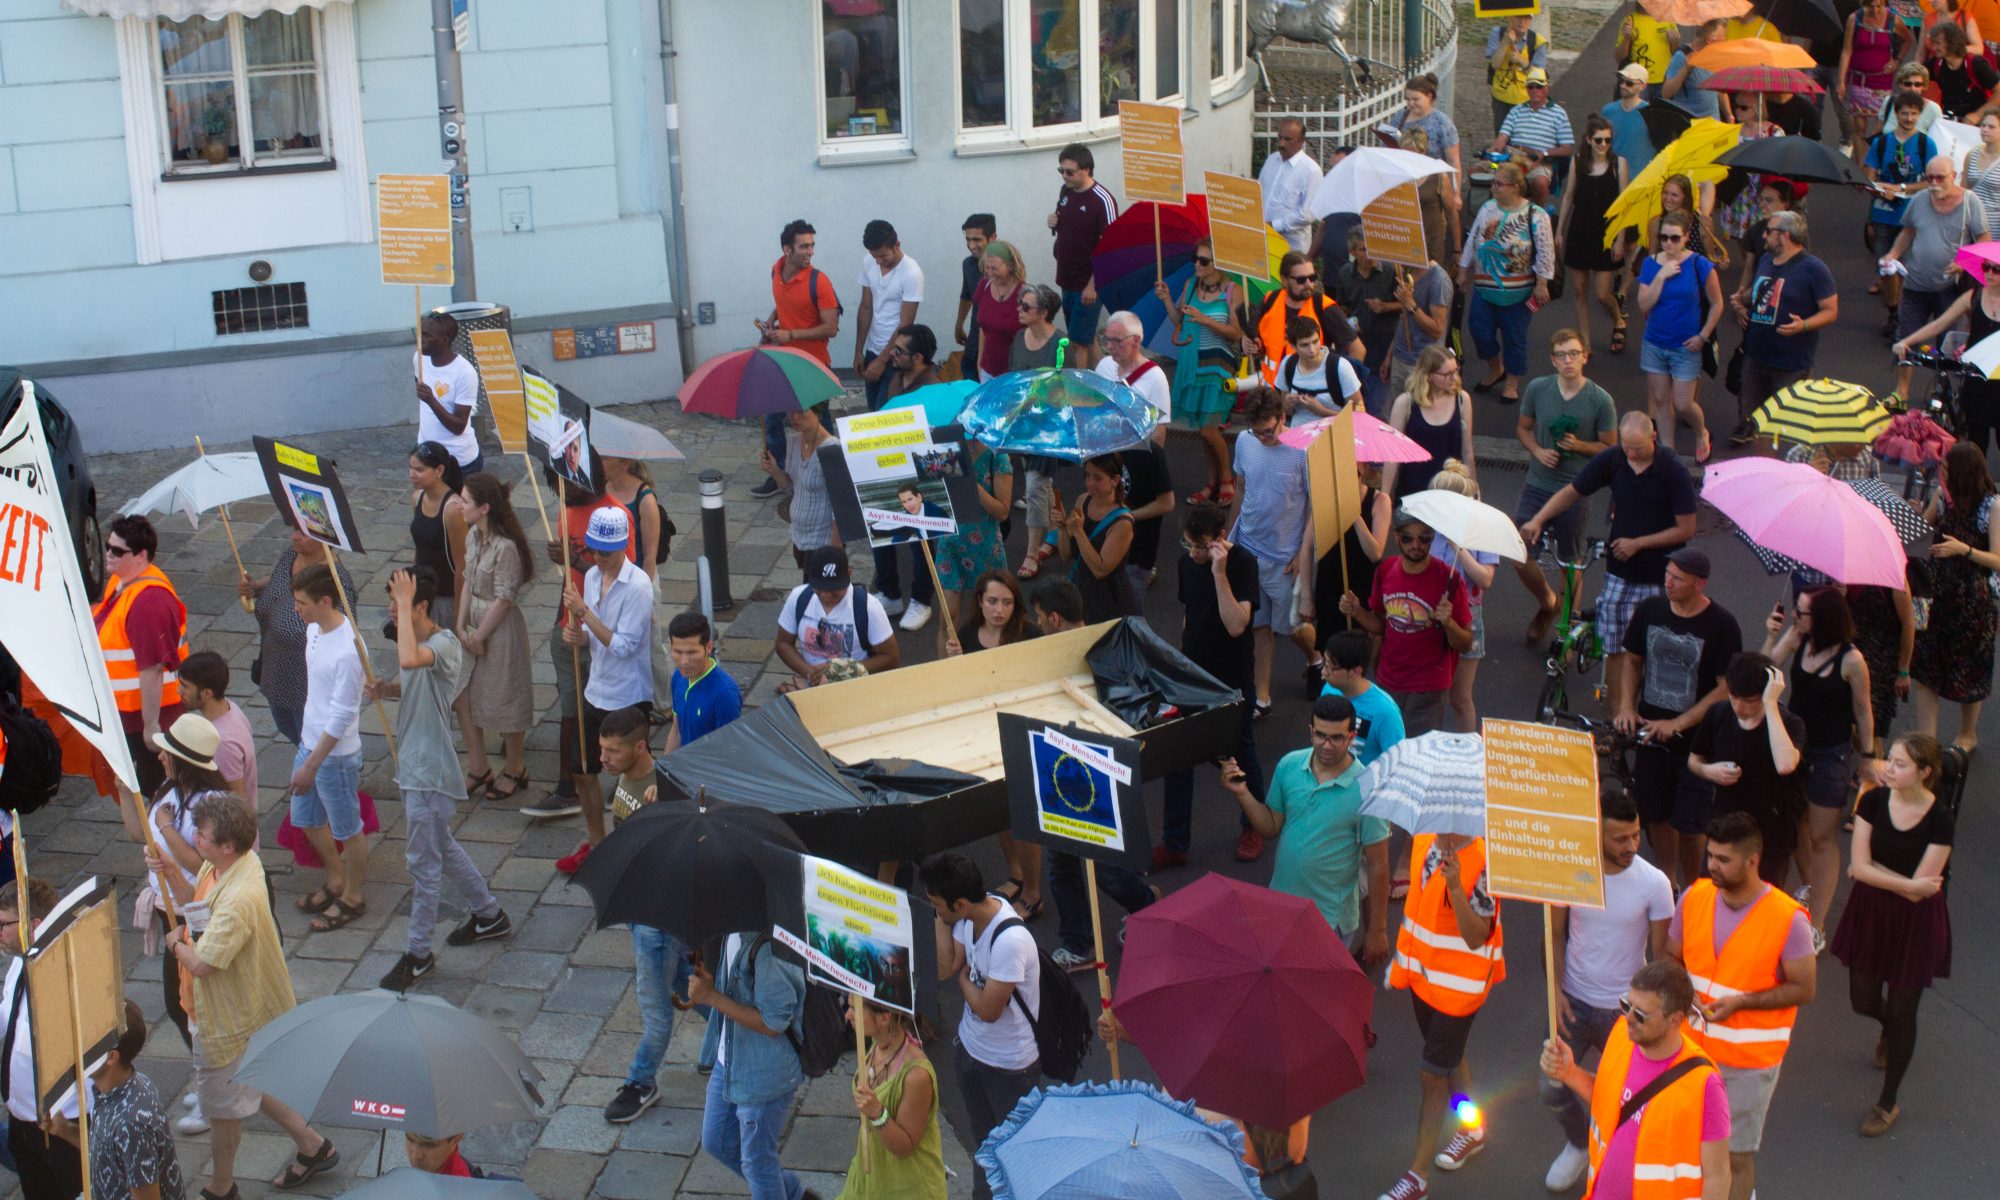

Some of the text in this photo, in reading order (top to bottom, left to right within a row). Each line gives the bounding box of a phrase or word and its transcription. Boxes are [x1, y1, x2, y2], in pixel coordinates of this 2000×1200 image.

[1364, 218, 1410, 234] Menschen
[1364, 229, 1410, 243] schützen!
[878, 414, 914, 426] hässliche
[848, 433, 927, 451] Bilder wird es nicht
[868, 511, 884, 521] Asyl
[892, 514, 949, 528] Menschenrecht
[1486, 722, 1591, 747] Wir fordern einen
[1048, 731, 1064, 747] Asyl
[1071, 743, 1126, 777] Menschenrecht
[1487, 737, 1568, 757] respektvollen
[1487, 750, 1536, 768] Umgang
[1488, 764, 1589, 787] mit geflüchteten
[1488, 777, 1548, 796] Menschen
[1505, 818, 1527, 830] und
[1531, 819, 1550, 833] die
[1489, 830, 1580, 851] Einhaltung der
[1489, 843, 1597, 867] Menschenrechte!
[817, 890, 844, 906] gegen
[835, 874, 856, 892] habe
[858, 884, 867, 896] ja
[869, 888, 897, 905] nichts
[778, 930, 797, 948] Asyl
[804, 948, 868, 993] Menschenrecht
[354, 1100, 391, 1115] WKO
